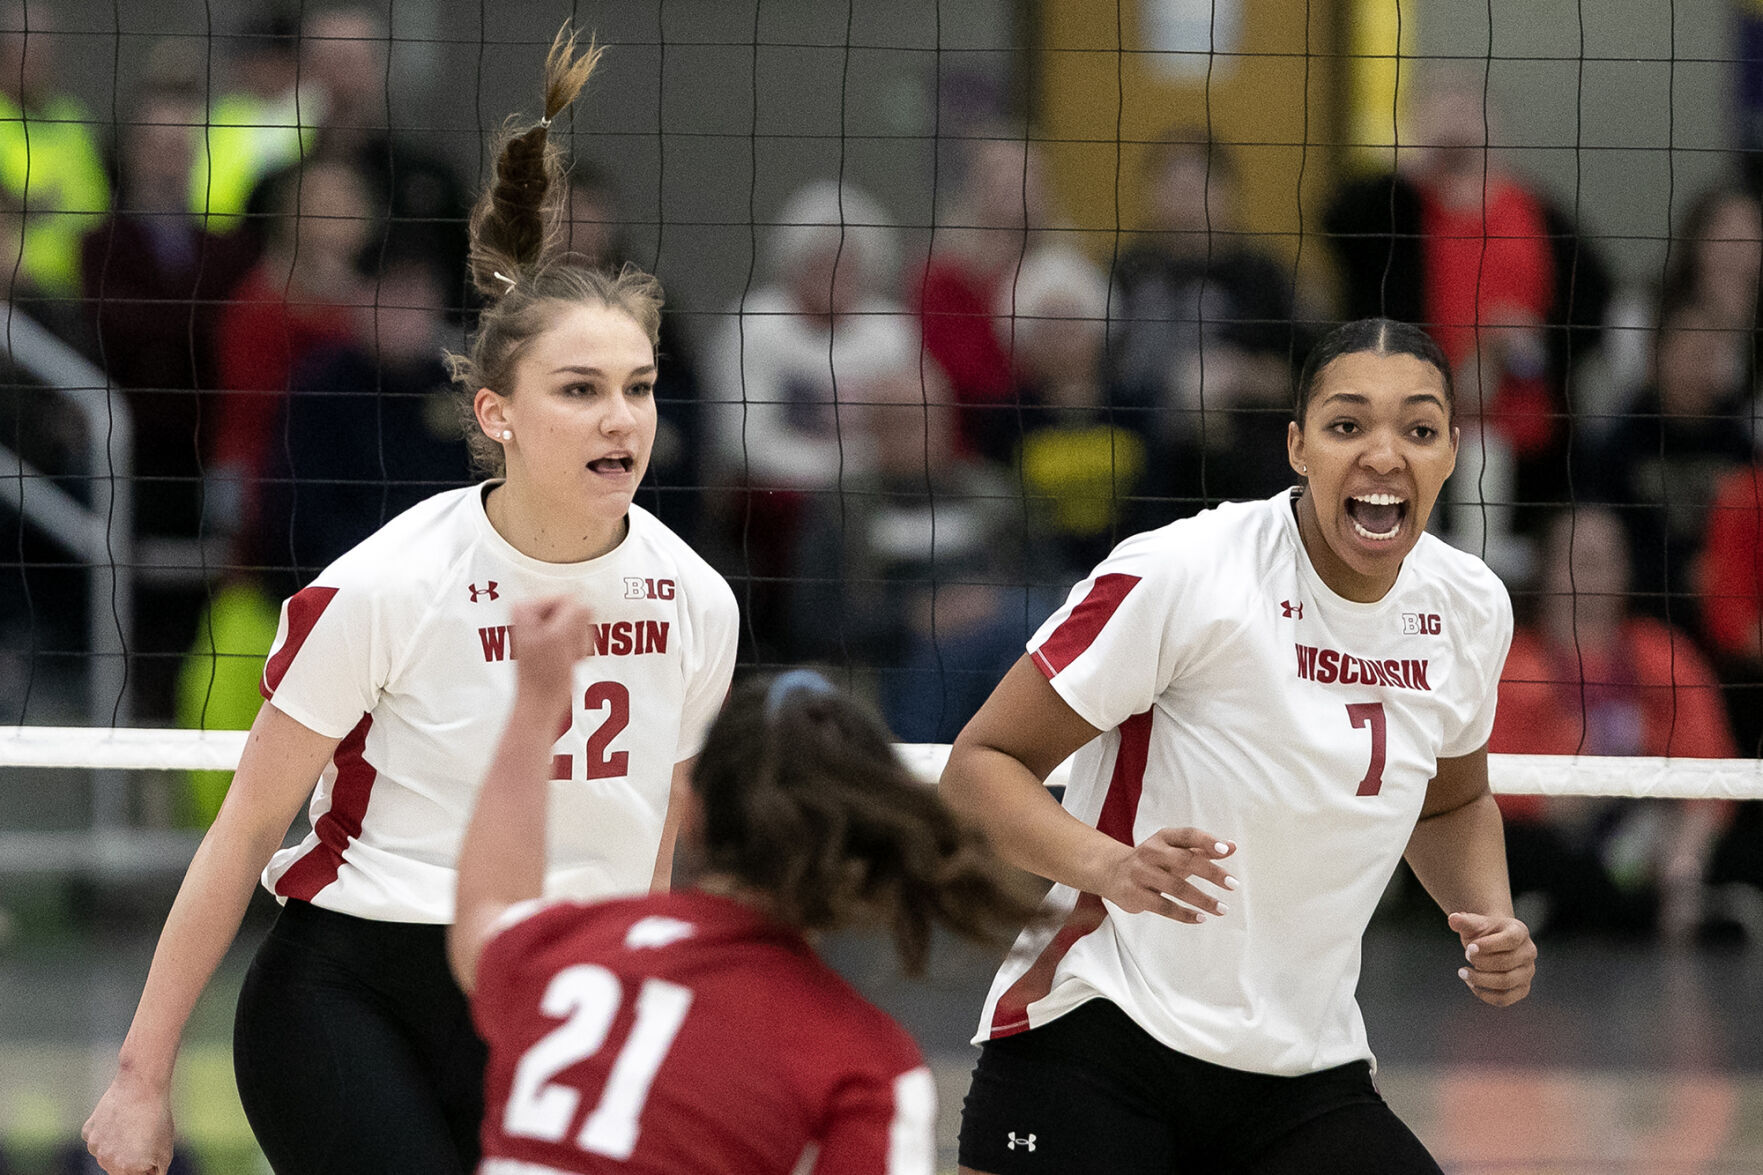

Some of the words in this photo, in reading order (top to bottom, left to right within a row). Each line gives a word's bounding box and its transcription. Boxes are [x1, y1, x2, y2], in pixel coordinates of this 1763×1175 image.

[1295, 643, 1431, 690] WISCONSIN
[1345, 702, 1386, 796] 7
[504, 964, 694, 1160] 21
